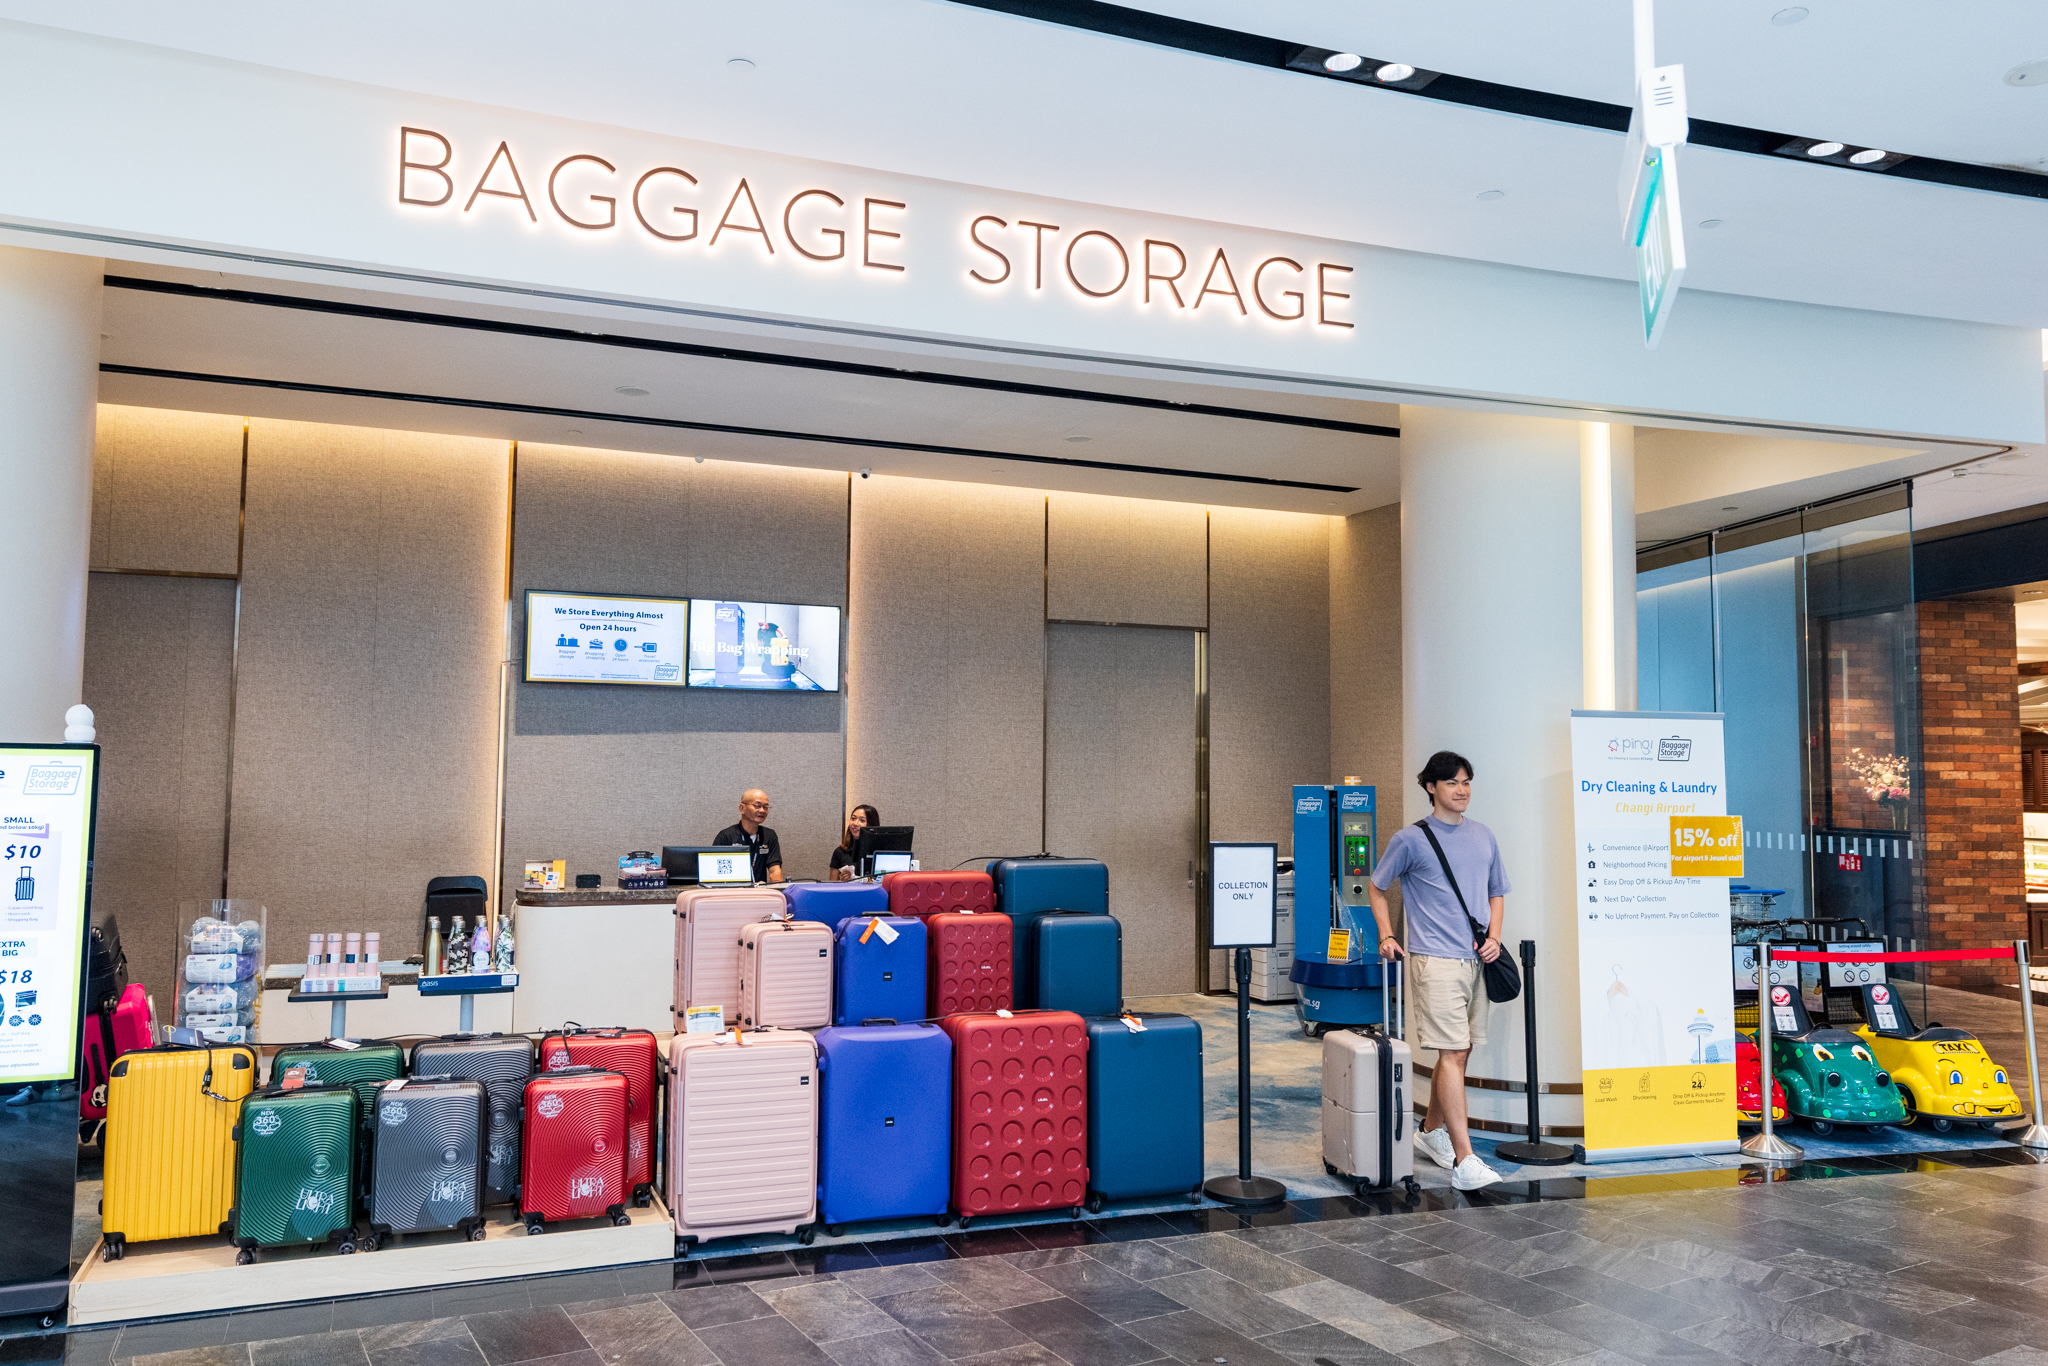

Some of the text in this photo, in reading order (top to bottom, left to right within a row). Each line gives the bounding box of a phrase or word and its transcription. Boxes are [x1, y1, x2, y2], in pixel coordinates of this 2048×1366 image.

[399, 126, 1355, 329] BAGGAGE STORAGE
[554, 607, 664, 620] We Store Everything Almost
[579, 623, 601, 632] Open
[614, 624, 637, 632] hours
[692, 640, 809, 659] Big Bag Wrapping
[1661, 741, 1690, 750] Baggage
[1660, 749, 1685, 758] Storage
[31, 768, 78, 780] Baggage
[28, 778, 69, 791] Storage
[1581, 780, 1718, 795] Dry Cleaning & Laundry
[1615, 802, 1696, 816] Changi Airport
[1674, 828, 1739, 847] 15% off
[4, 844, 42, 861] $10
[1643, 844, 1669, 852] @Airport
[1683, 855, 1704, 863] airport
[1647, 861, 1668, 869] Pricing
[1218, 881, 1268, 890] COLLECTION
[1232, 892, 1255, 900] ONLY
[1616, 913, 1639, 921] Upfront
[0, 940, 26, 948] XTRA
[2, 949, 19, 957] BIG
[0, 969, 33, 986] $18
[1938, 1043, 1972, 1052] TAXI
[1691, 1081, 1703, 1089] 24
[432, 1180, 467, 1192] ULTRA
[572, 1177, 605, 1189] ULTRA
[300, 1188, 335, 1206] ULTRA
